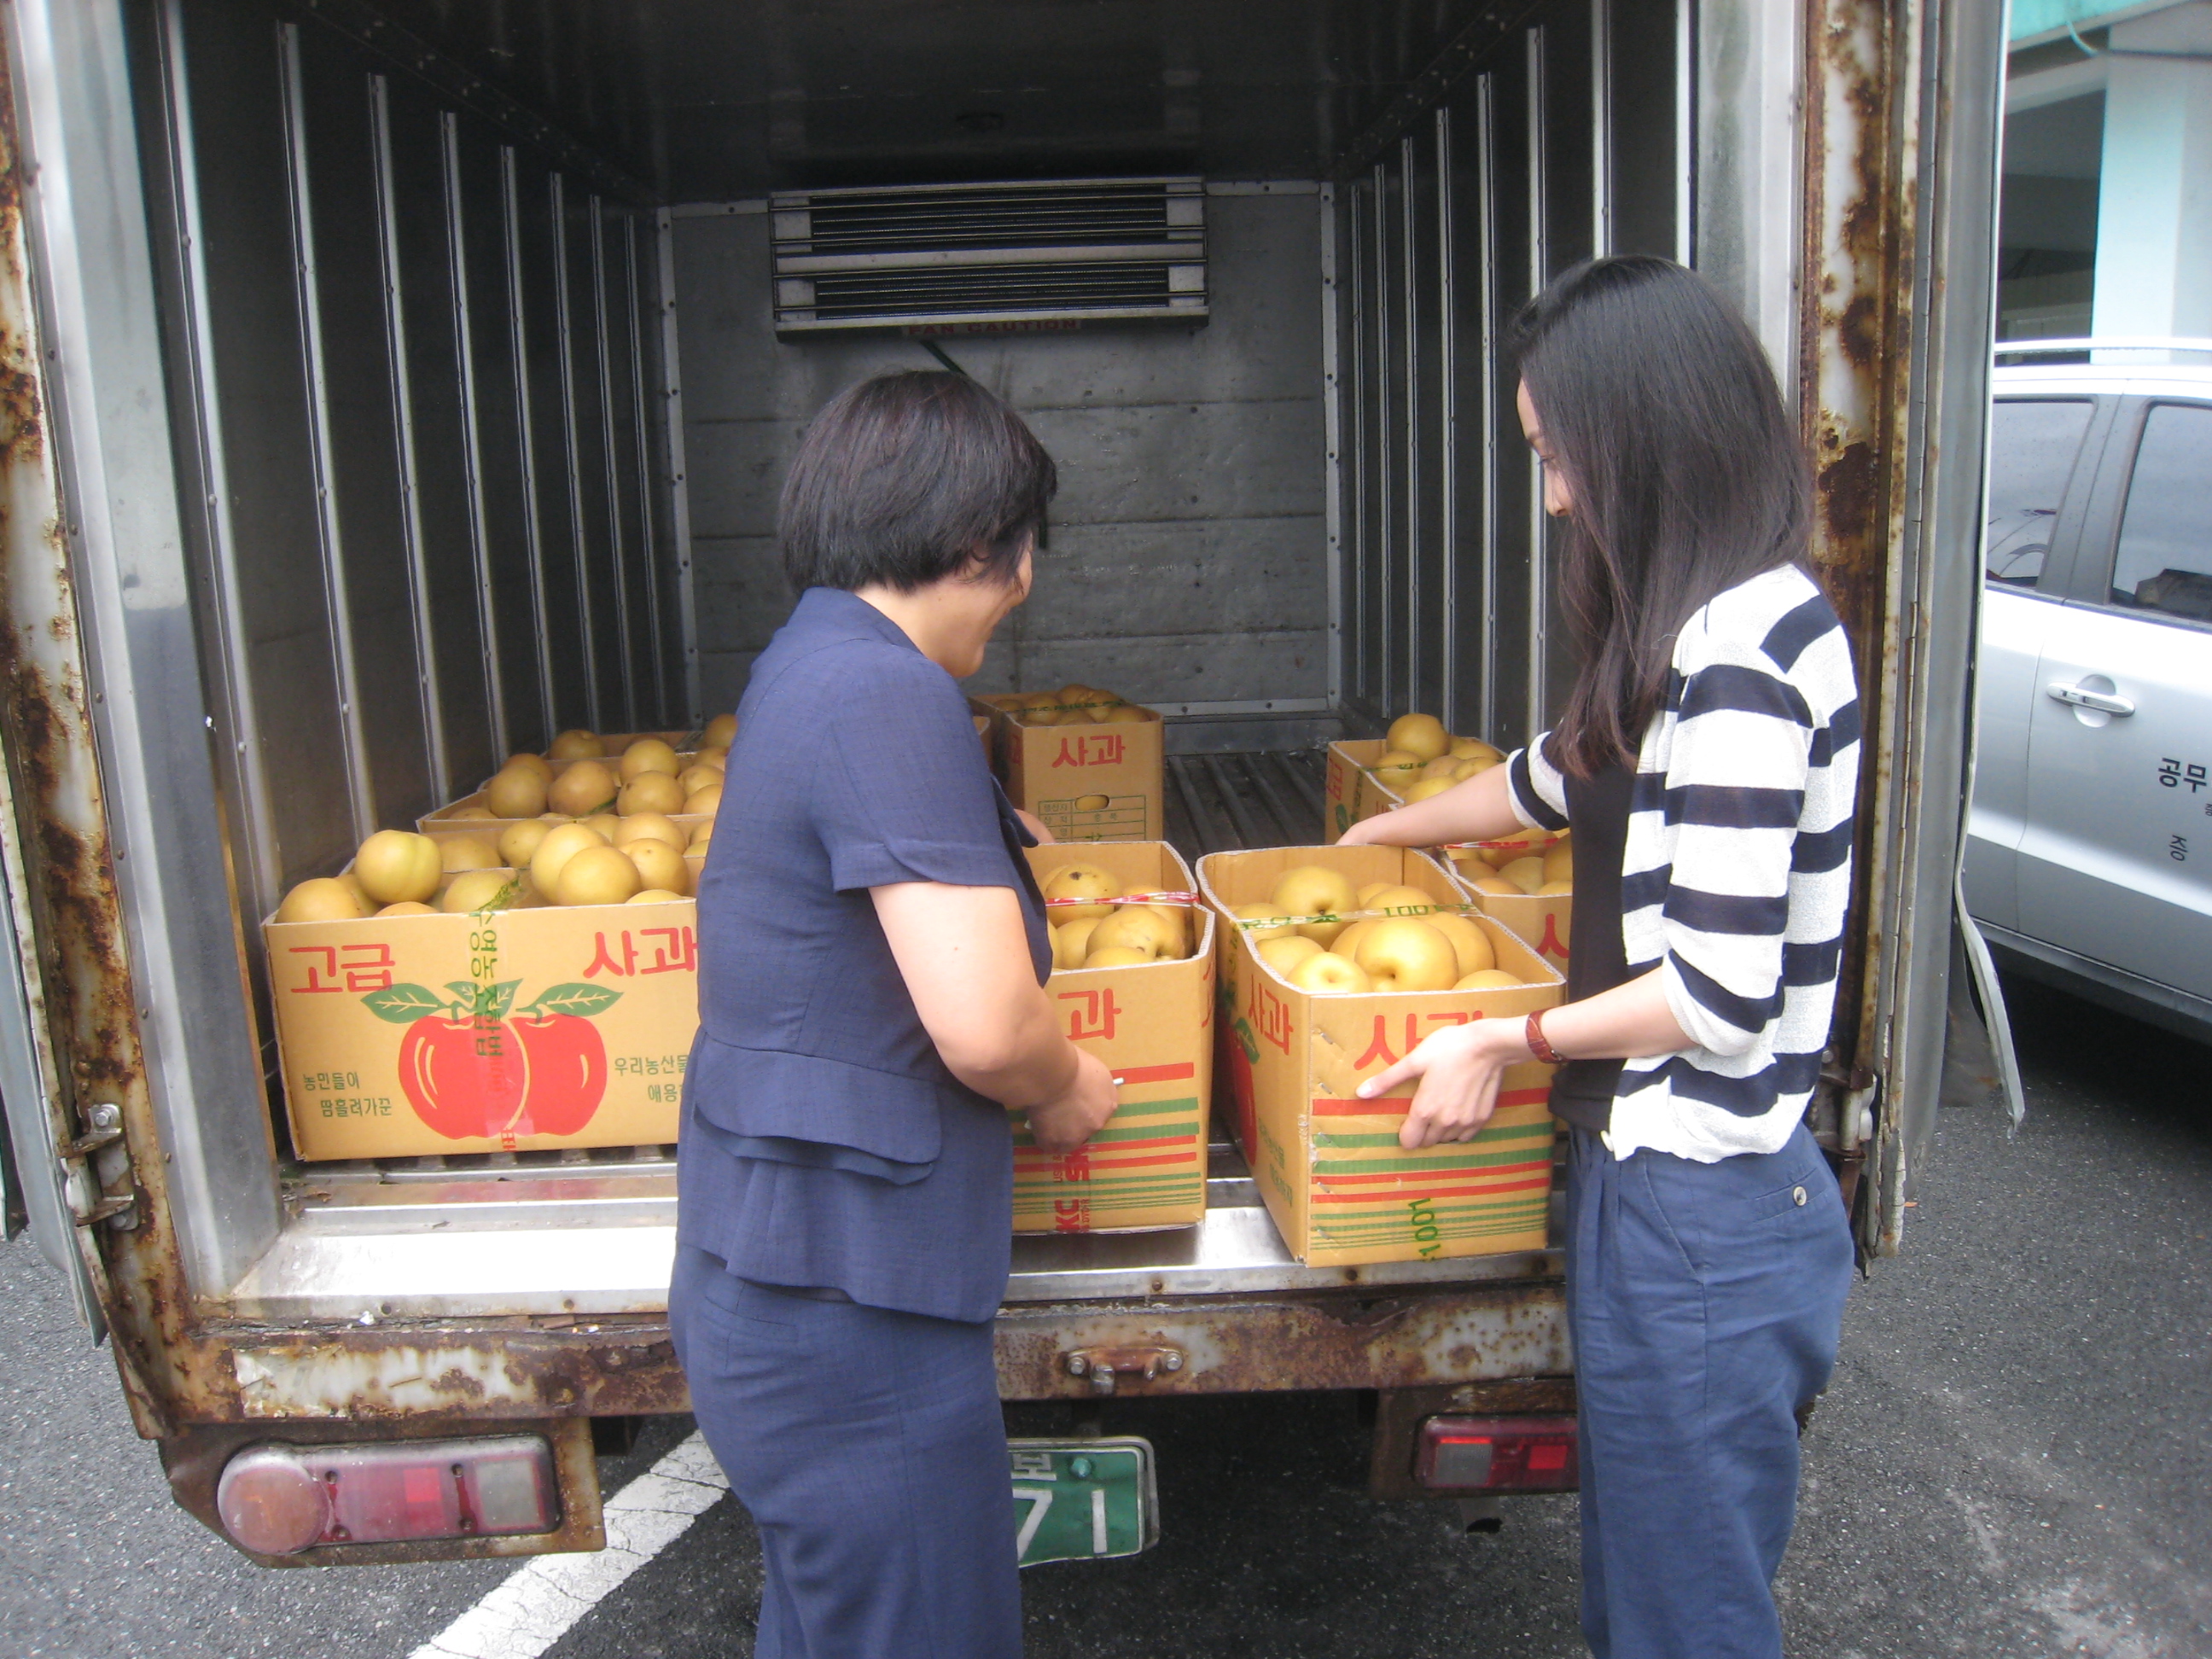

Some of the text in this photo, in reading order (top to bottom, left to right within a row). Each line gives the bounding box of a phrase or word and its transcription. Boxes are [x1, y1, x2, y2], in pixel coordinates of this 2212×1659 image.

[909, 319, 1078, 335] FAN CAUTION
[1051, 735, 1126, 768] 사과
[2158, 758, 2207, 794] 공무
[288, 926, 697, 993] 고급 사과
[1057, 988, 1121, 1040] 과
[1249, 974, 1294, 1057] 사과
[303, 1072, 360, 1091] 농민들이
[614, 1054, 690, 1076] 우리농산물
[321, 1098, 392, 1118] 땀흘려가꾼
[648, 1084, 684, 1103] 애용
[1012, 1488, 1108, 1562] 71
